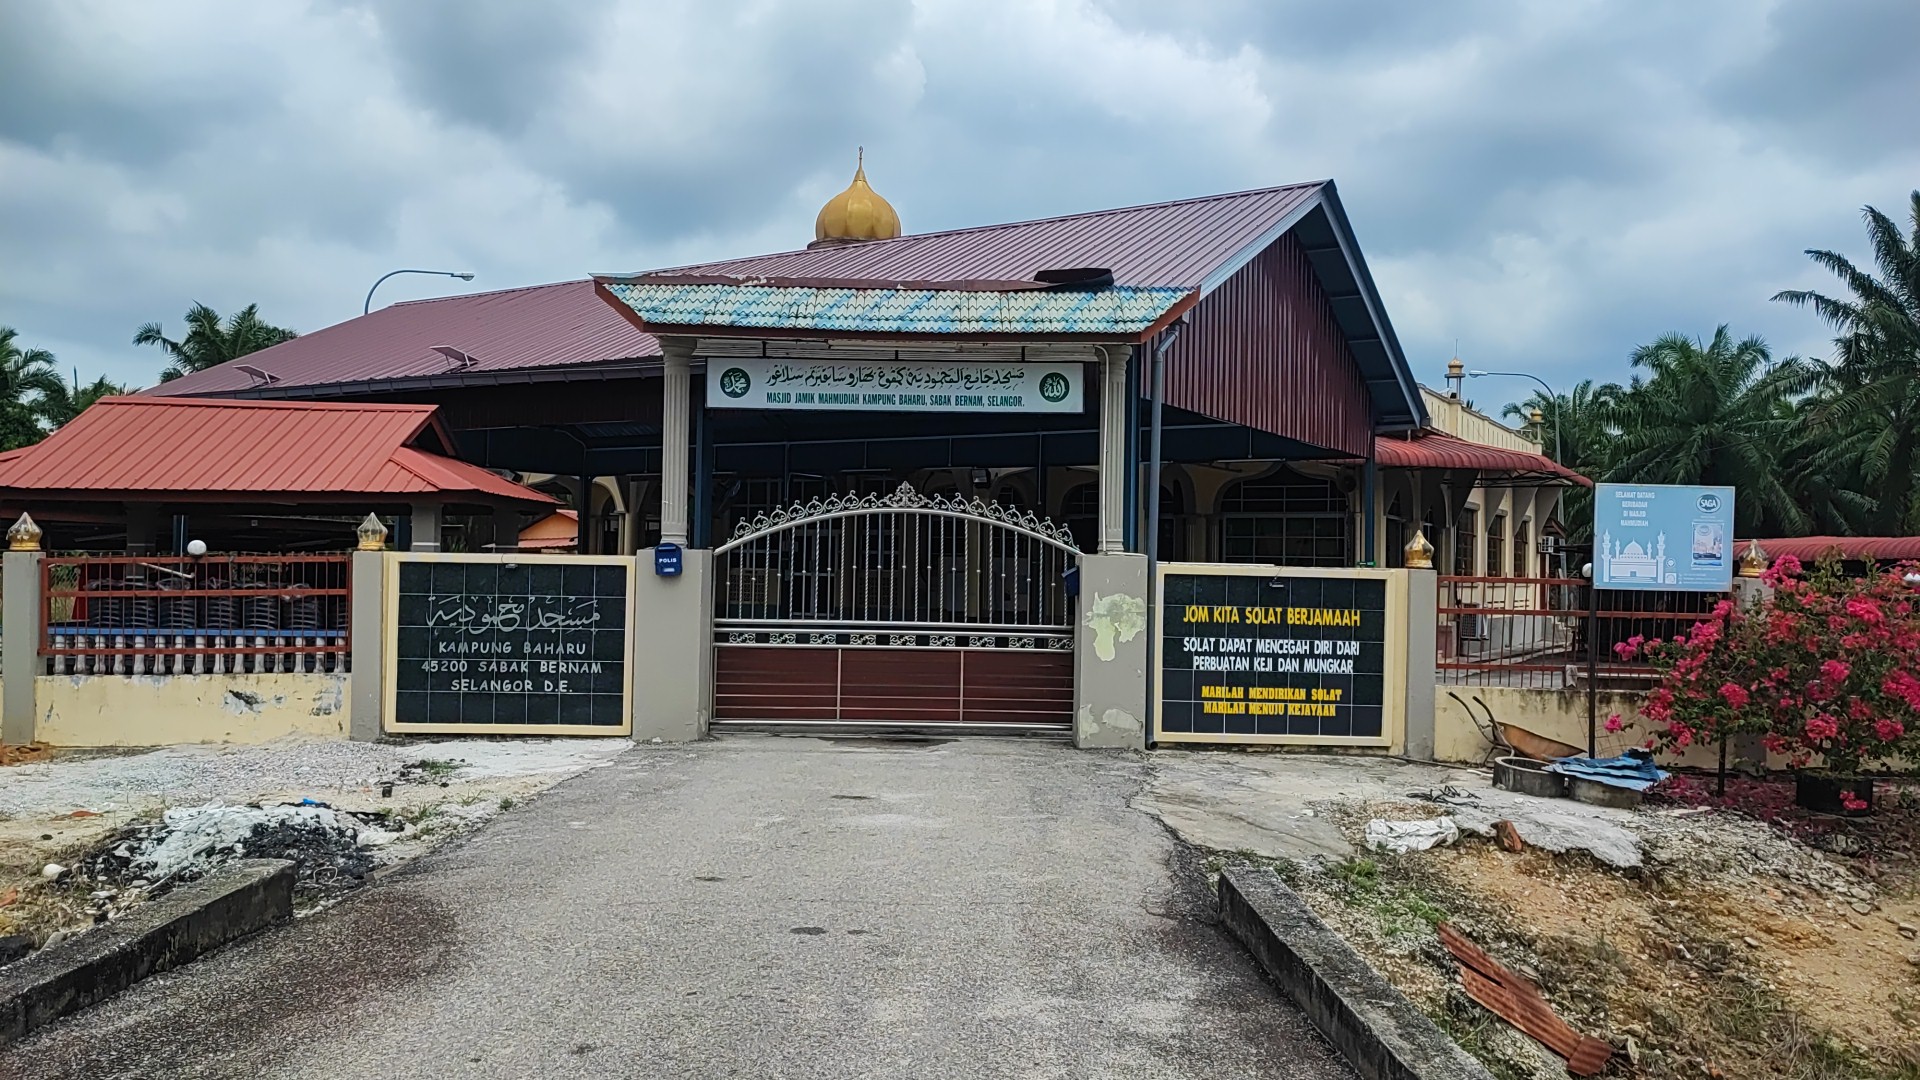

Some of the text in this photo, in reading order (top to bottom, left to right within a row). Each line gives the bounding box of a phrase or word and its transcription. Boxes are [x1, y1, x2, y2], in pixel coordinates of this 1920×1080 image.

[767, 392, 1025, 408] MASJID JAMIK MAHMUDIAH KAMPUNG BAHARU, SABAK BERNAM, SELANGOR.
[1700, 499, 1717, 508] SAGA
[1183, 605, 1361, 627] JOM KITA SOLAT BERJAMAAH
[438, 641, 586, 655] KAMPUNG BAHARU
[1183, 637, 1360, 656] SOLAT DAPAT MENCEGAH DIRI DARI
[421, 660, 602, 674] 45200 SABAK BERNAM
[1193, 656, 1354, 673] PERBUATAN KEJI DAN MUNGKAR
[451, 679, 573, 693] SELANGOR D.E.
[1201, 686, 1343, 701] MARILAH MENDIRIKAN SOLAT
[1203, 702, 1336, 717] MARILAH MENUJU KEJAYAAN
